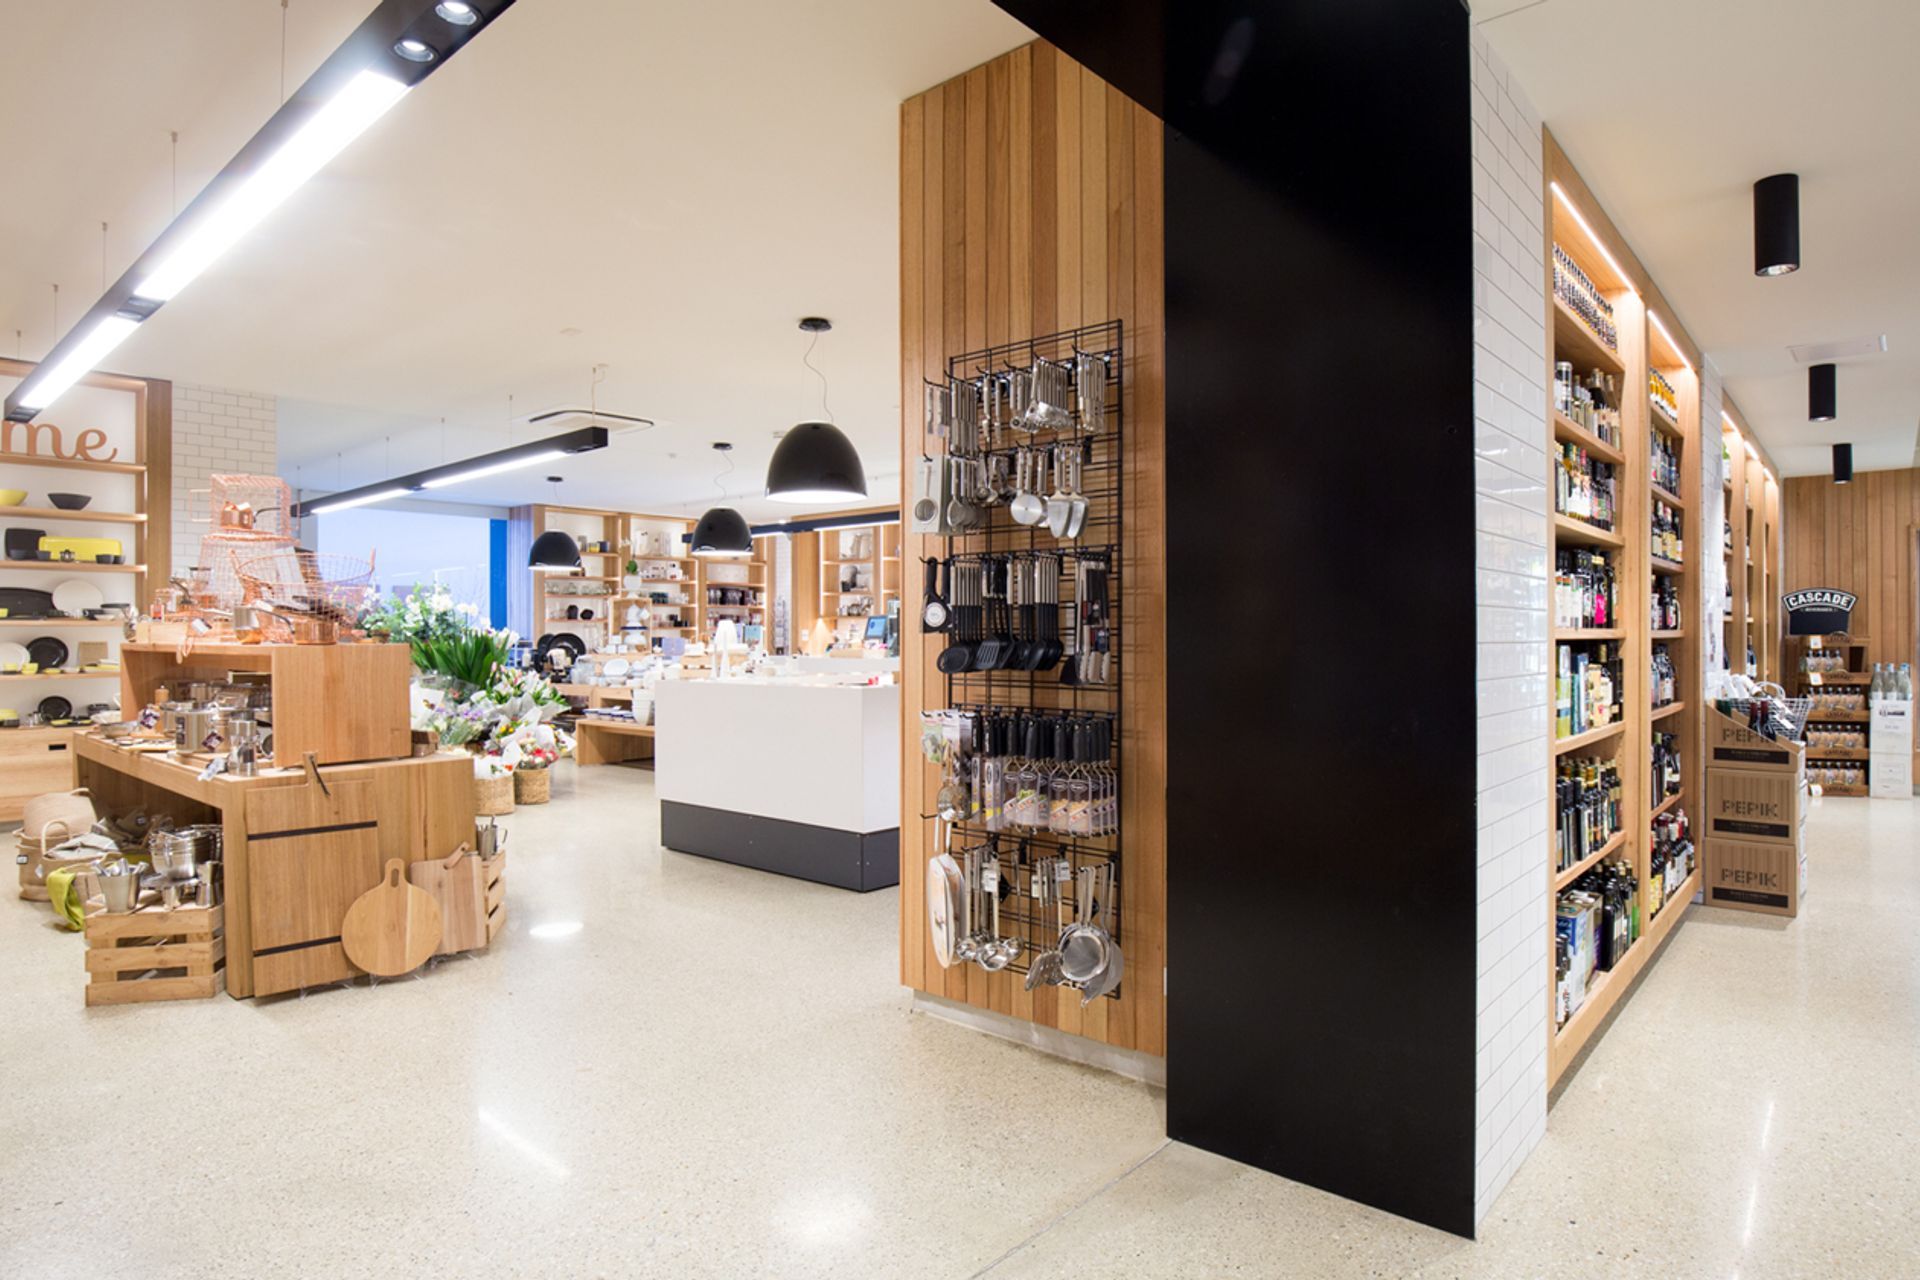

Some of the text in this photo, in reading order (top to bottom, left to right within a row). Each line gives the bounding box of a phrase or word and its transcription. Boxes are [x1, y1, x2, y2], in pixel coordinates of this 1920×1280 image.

[1788, 592, 1850, 607] CASCADE
[1722, 728, 1770, 743] PEP
[1722, 800, 1778, 817] PEPIK
[1721, 868, 1777, 887] PEPIK
